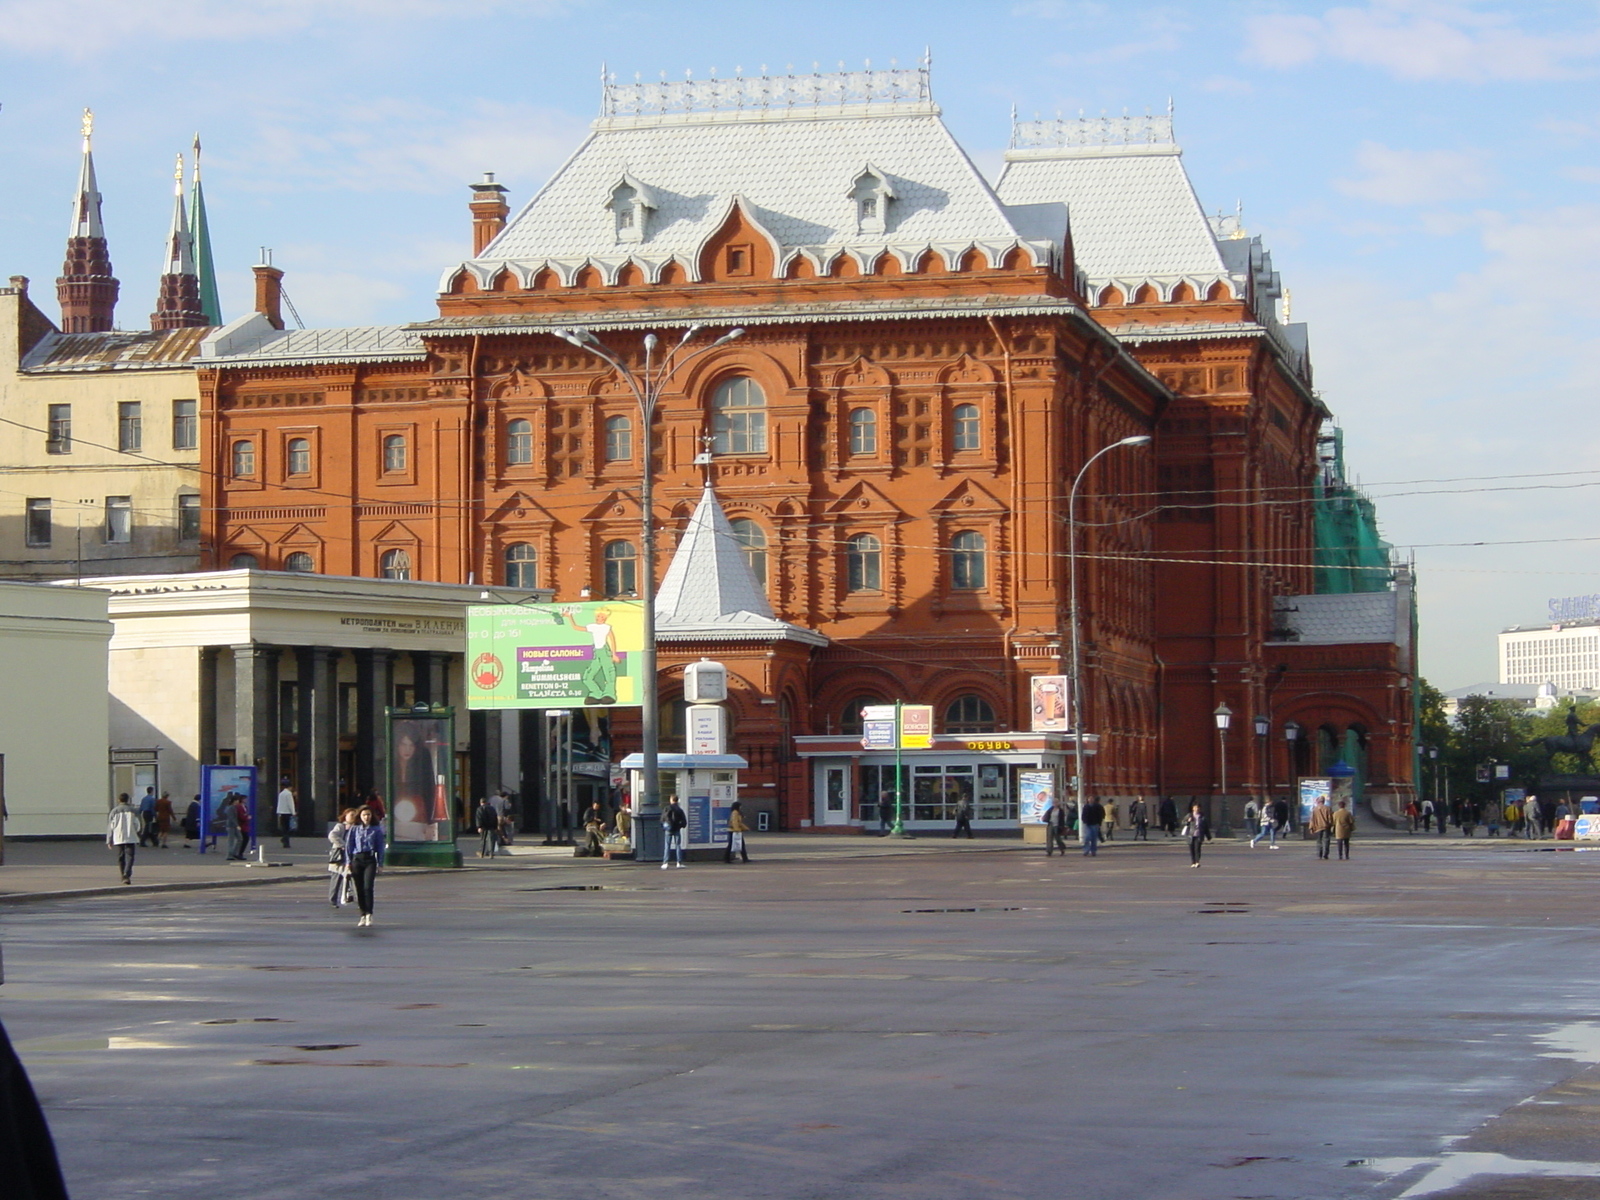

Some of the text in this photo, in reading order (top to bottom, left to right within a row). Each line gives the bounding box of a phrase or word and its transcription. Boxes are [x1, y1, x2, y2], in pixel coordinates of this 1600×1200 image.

[522, 649, 584, 658] НОВЫЕ САЛОНЫ:
[521, 682, 554, 690] BENETTON
[967, 741, 1011, 750] ОБУВЬ
